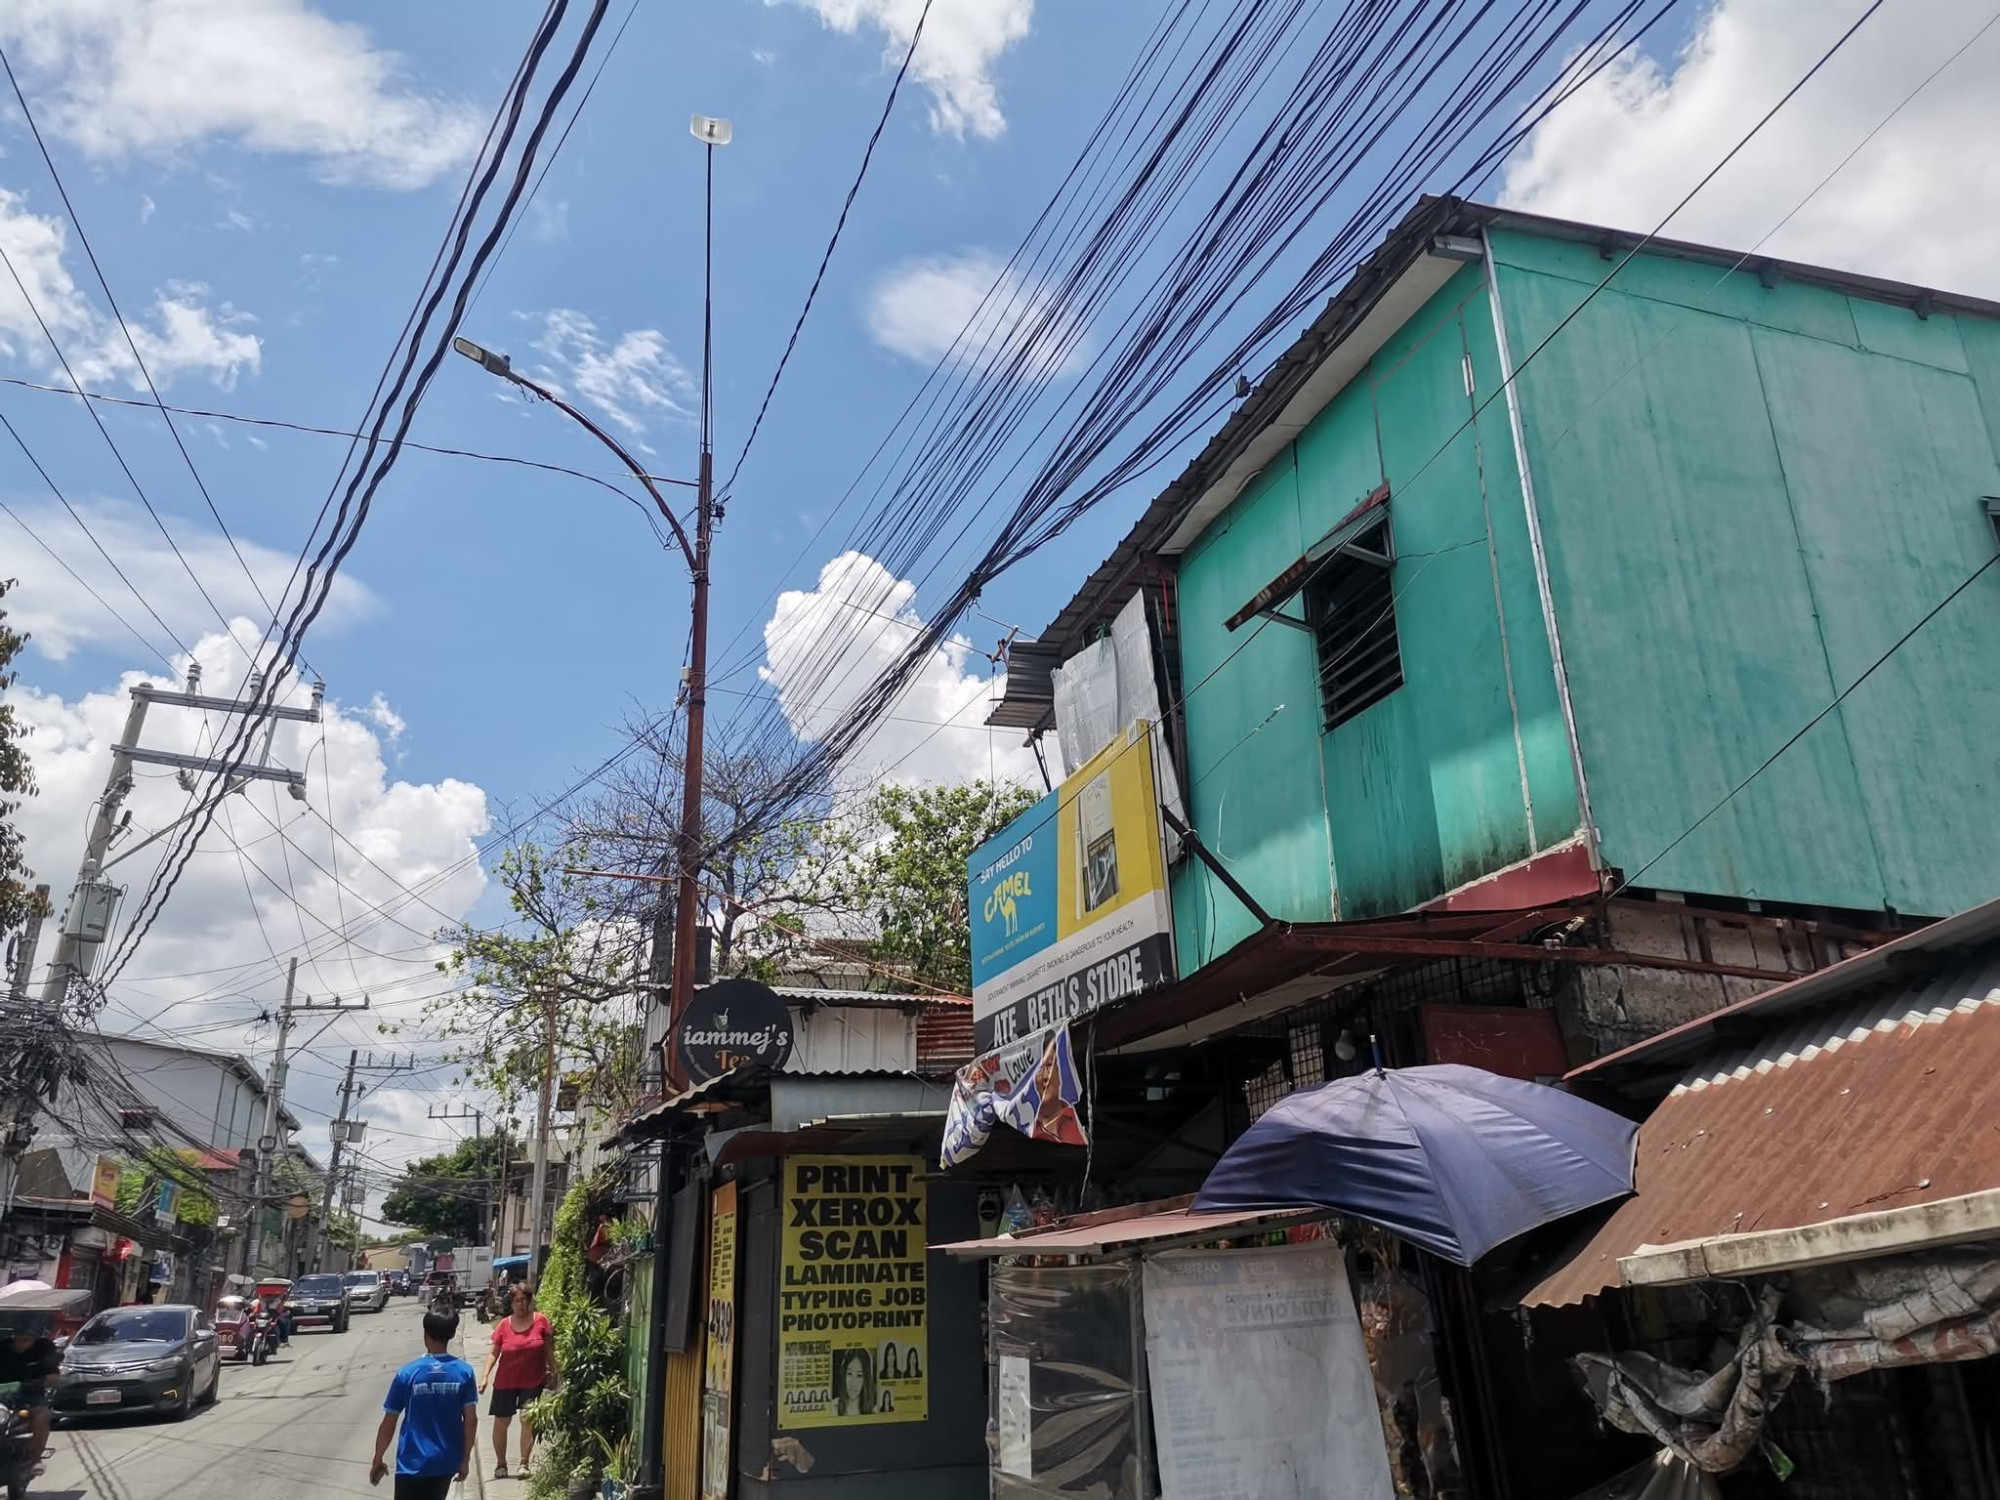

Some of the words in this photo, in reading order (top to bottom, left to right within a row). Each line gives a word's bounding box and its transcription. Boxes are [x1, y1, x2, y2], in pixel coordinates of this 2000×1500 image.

[980, 865, 996, 884] SAY
[995, 846, 1020, 874] HELLO
[1021, 836, 1033, 856] TO
[984, 871, 1032, 923] CAMEL
[1026, 963, 1046, 983] CIGARETTE
[1046, 955, 1065, 971] SMOKING
[1069, 939, 1096, 960] DANGEROUS
[1096, 936, 1103, 947] TO
[1102, 928, 1116, 943] YOUR
[1116, 919, 1135, 936] HEALTH
[993, 1006, 1018, 1047] ATE
[1027, 976, 1079, 1029] BETH'S
[1086, 947, 1144, 1011] STORE
[683, 1024, 788, 1055] iammej's
[1004, 1045, 1035, 1085] Louie
[796, 1164, 914, 1194] PRINT
[790, 1197, 922, 1227] XEROX
[798, 1229, 908, 1261] SCAN
[784, 1262, 925, 1286] LAMINATE
[781, 1288, 872, 1310] TYPING
[879, 1287, 926, 1307] JOB
[782, 1310, 925, 1332] PHOTOPRINT
